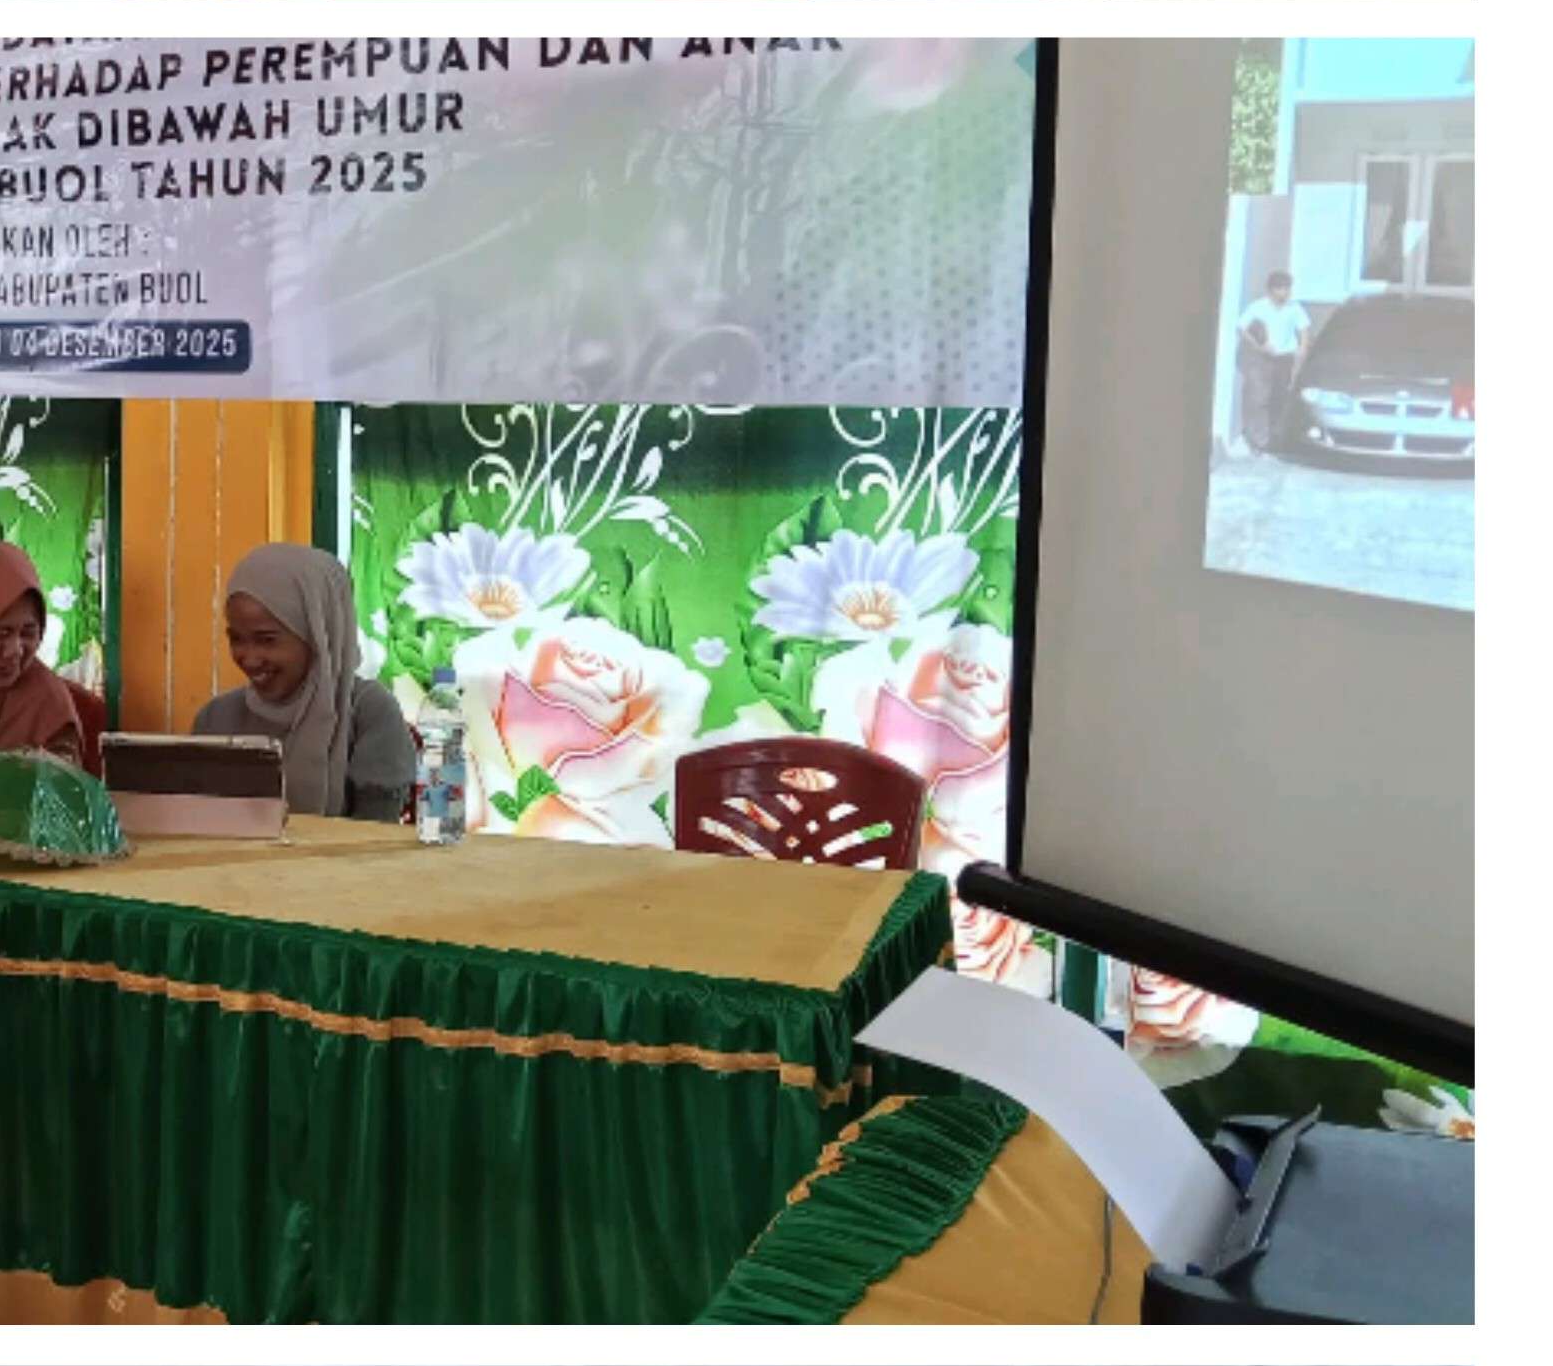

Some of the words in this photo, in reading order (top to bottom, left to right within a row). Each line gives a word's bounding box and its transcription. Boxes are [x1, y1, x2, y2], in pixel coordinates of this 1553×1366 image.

[202, 37, 510, 87] PEREMPUAN
[540, 37, 652, 67] DAN
[78, 99, 290, 150] DIBAWAH
[317, 92, 463, 136] UMUR
[132, 157, 285, 199] TAHUN
[309, 151, 427, 194] 2025
[66, 223, 130, 258] OLEH
[140, 270, 208, 305] BUOL
[175, 329, 237, 357] 2025
